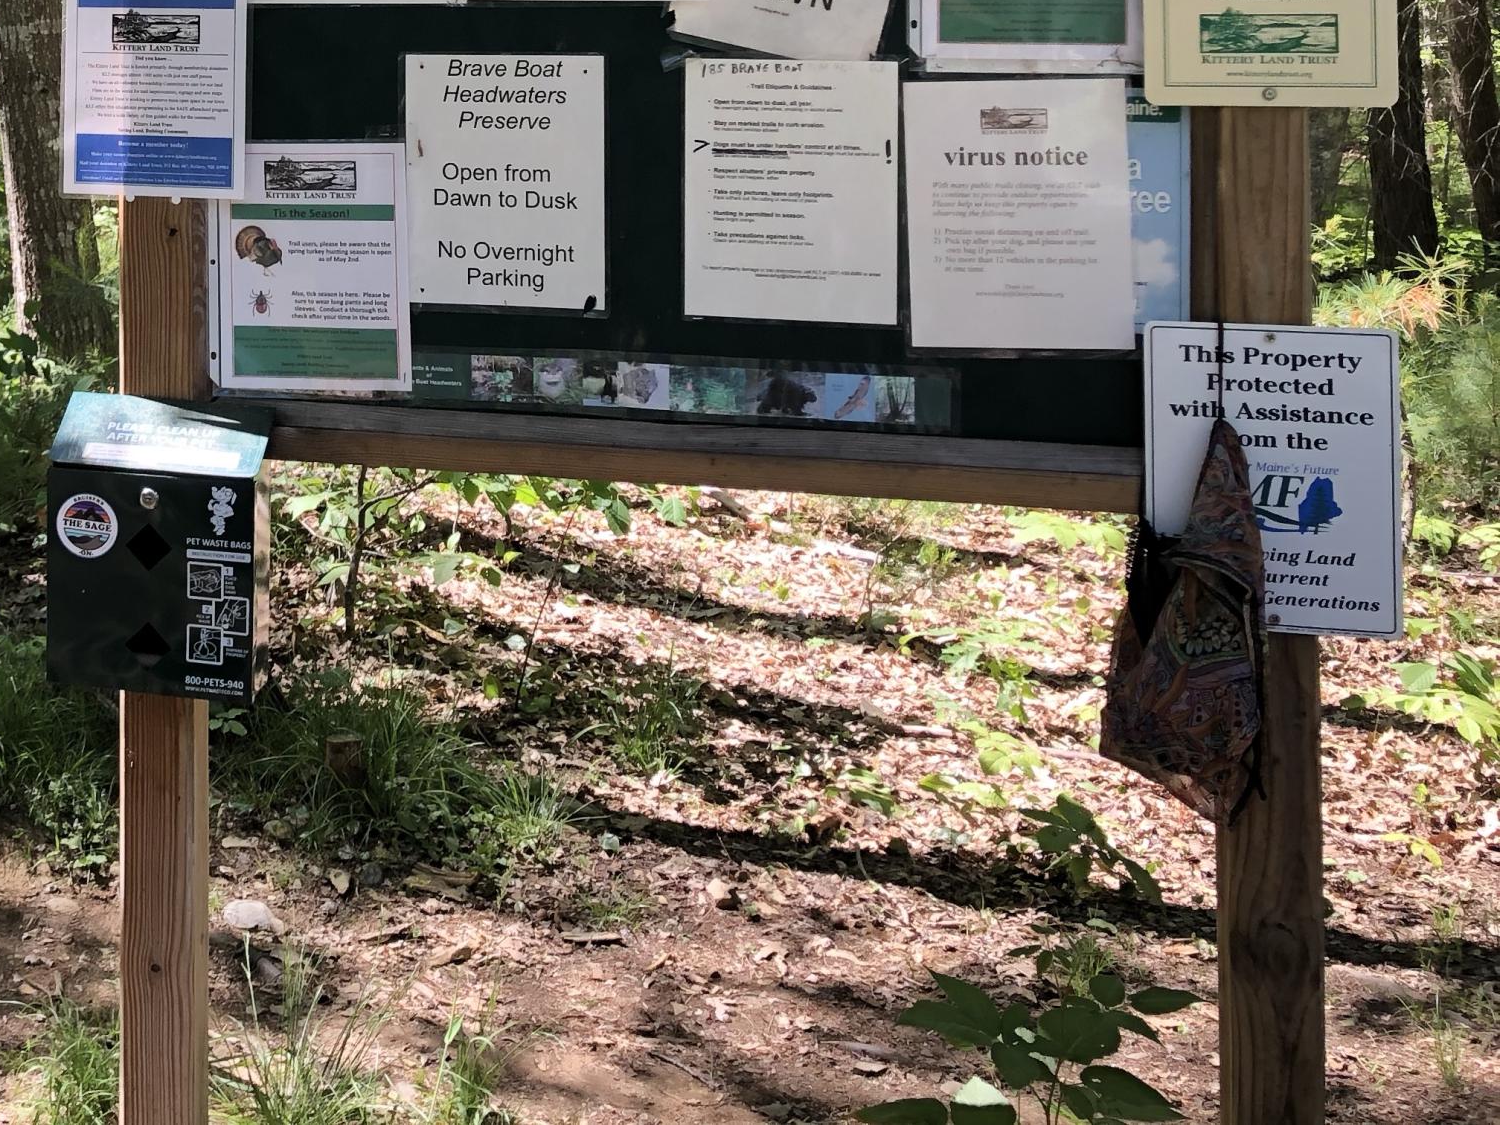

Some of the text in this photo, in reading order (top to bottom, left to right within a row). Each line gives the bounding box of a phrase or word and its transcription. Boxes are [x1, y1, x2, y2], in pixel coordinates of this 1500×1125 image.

[447, 59, 563, 77] Brave Boat
[732, 63, 769, 73] BRAVE
[1202, 55, 1339, 64] KITTERY LAND TRUST
[443, 85, 567, 103] Headwaters
[459, 111, 551, 129] Preserve
[944, 146, 1088, 165] virus notice
[443, 163, 550, 184] Open from
[434, 189, 578, 209] Dawn to Dusk
[290, 209, 306, 218] the
[309, 209, 350, 218] Season!
[439, 241, 574, 266] No Overnight
[468, 268, 544, 292] Parking
[1179, 345, 1362, 373] This Property
[1207, 374, 1335, 395] Protected
[1170, 400, 1374, 425] with Assistance
[1238, 432, 1328, 450] om the
[1256, 462, 1299, 473] Maine's
[1303, 464, 1339, 475] Future
[63, 519, 112, 532] THE SAGE
[202, 539, 228, 548] WASTE
[230, 541, 251, 549] BAGS
[1305, 550, 1356, 566] Land
[1266, 572, 1329, 586] urrent
[1264, 590, 1380, 612] Generations
